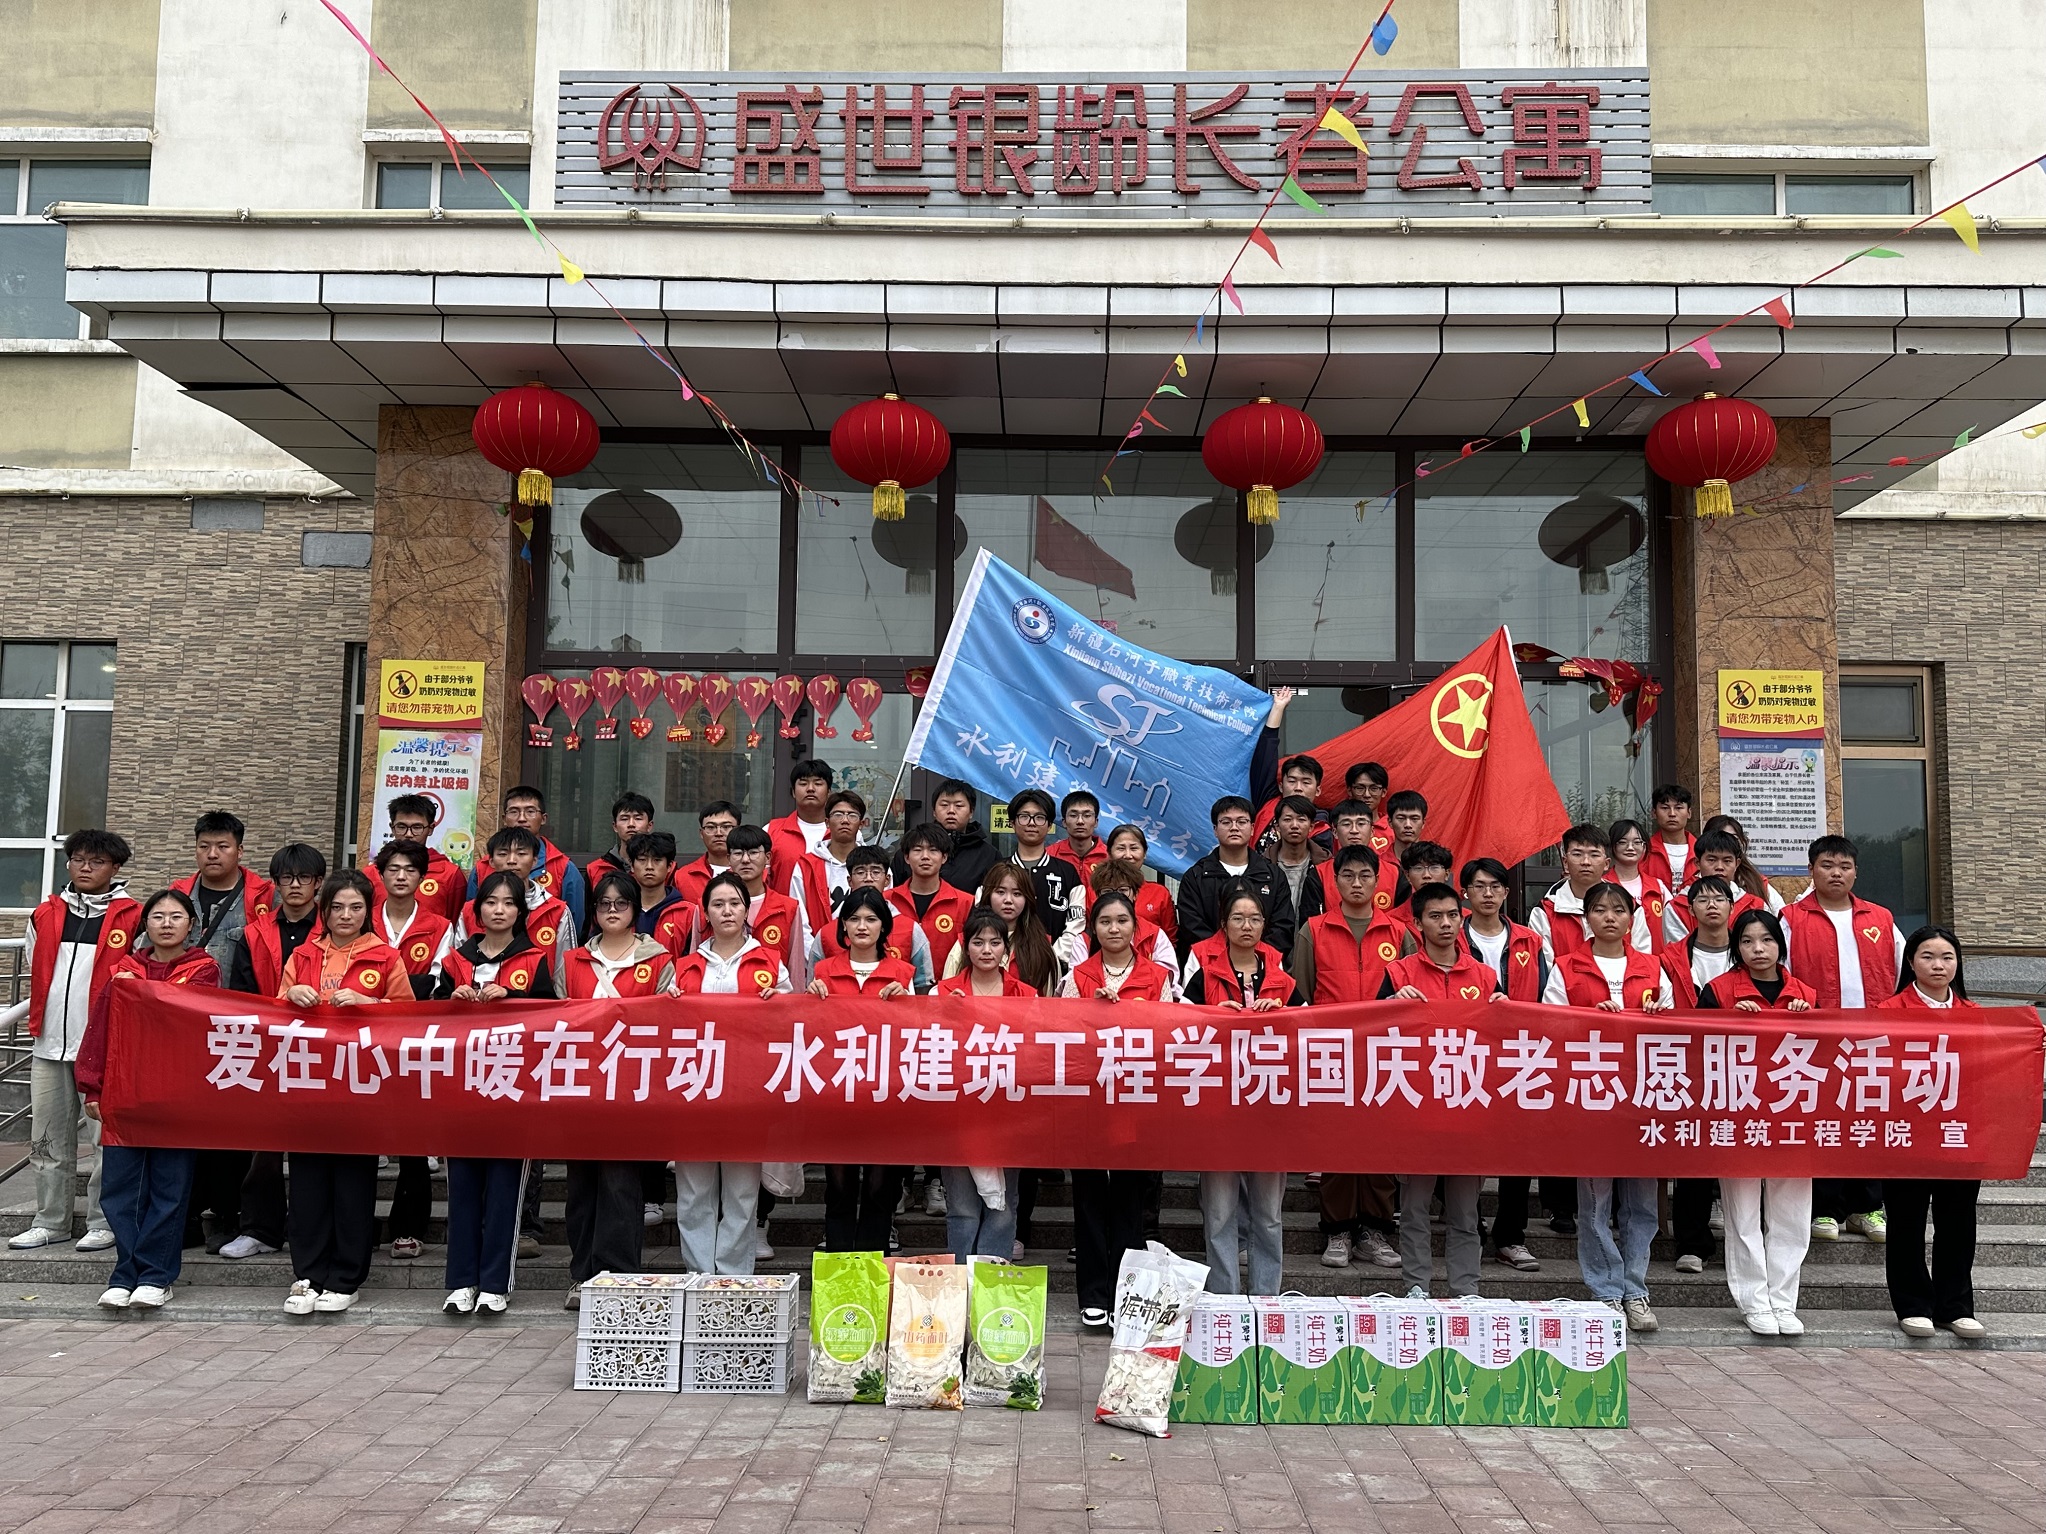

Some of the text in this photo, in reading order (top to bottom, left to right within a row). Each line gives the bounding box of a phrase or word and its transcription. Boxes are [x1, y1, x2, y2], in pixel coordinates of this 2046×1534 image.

[729, 83, 1603, 197] 盛世银龄长者公寓
[418, 687, 477, 697] 奶奶对宠物过敏
[424, 674, 474, 684] 由于部分爷爷
[1063, 643, 1101, 670] Xinjiang
[1101, 660, 1136, 684] Shihezi
[1136, 676, 1186, 706] Vocational
[1226, 715, 1254, 736] College
[1763, 684, 1813, 694] 由于部分爷爷
[386, 702, 477, 715] 请您勿带宠物入内
[1758, 697, 1817, 707] 奶奶对宠物过敏
[1726, 712, 1818, 725] 请您勿带宠物入内
[391, 737, 473, 758] 温馨提示
[385, 774, 470, 790] 院内禁止吸烟
[206, 1015, 1960, 1114] 爱在心中暖在行动 水利建筑工程学院国庆敬老志愿服务活动
[1639, 1118, 1970, 1149] 水利建筑工程学院 宣
[1213, 1314, 1233, 1362] 纯牛奶
[1307, 1316, 1327, 1363] 纯牛奶
[1398, 1316, 1418, 1363] 纯牛奶
[1492, 1316, 1512, 1364] 纯牛奶
[1585, 1319, 1604, 1366] 纯牛奶
